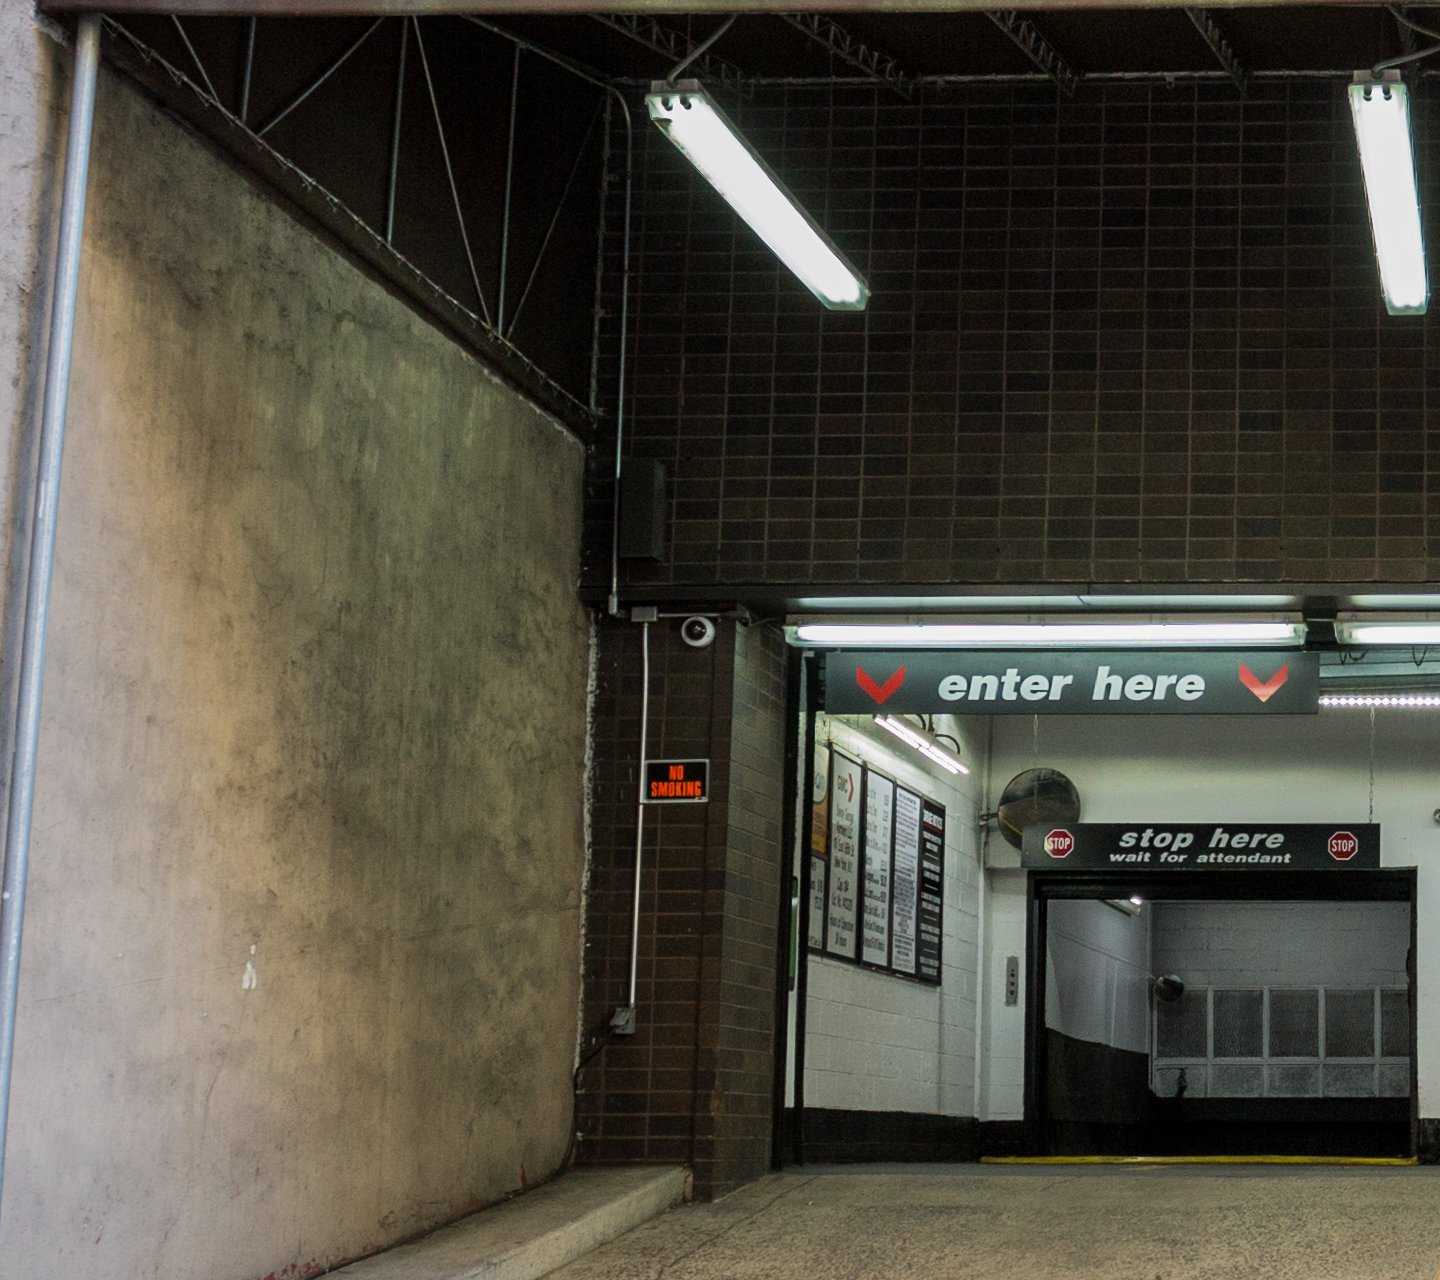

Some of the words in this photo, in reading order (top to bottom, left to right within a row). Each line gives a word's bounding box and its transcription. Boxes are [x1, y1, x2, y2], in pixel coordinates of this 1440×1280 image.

[937, 668, 1074, 701] enter
[1091, 666, 1206, 701] here
[669, 765, 684, 780] NO
[651, 781, 702, 797] SMOKING
[1047, 837, 1072, 850] STOP
[1119, 828, 1194, 851] stop
[1208, 828, 1286, 849] here
[1331, 839, 1355, 852] STOP
[1109, 851, 1151, 864] wait
[1160, 851, 1188, 864] for
[1196, 852, 1292, 864] attendant
